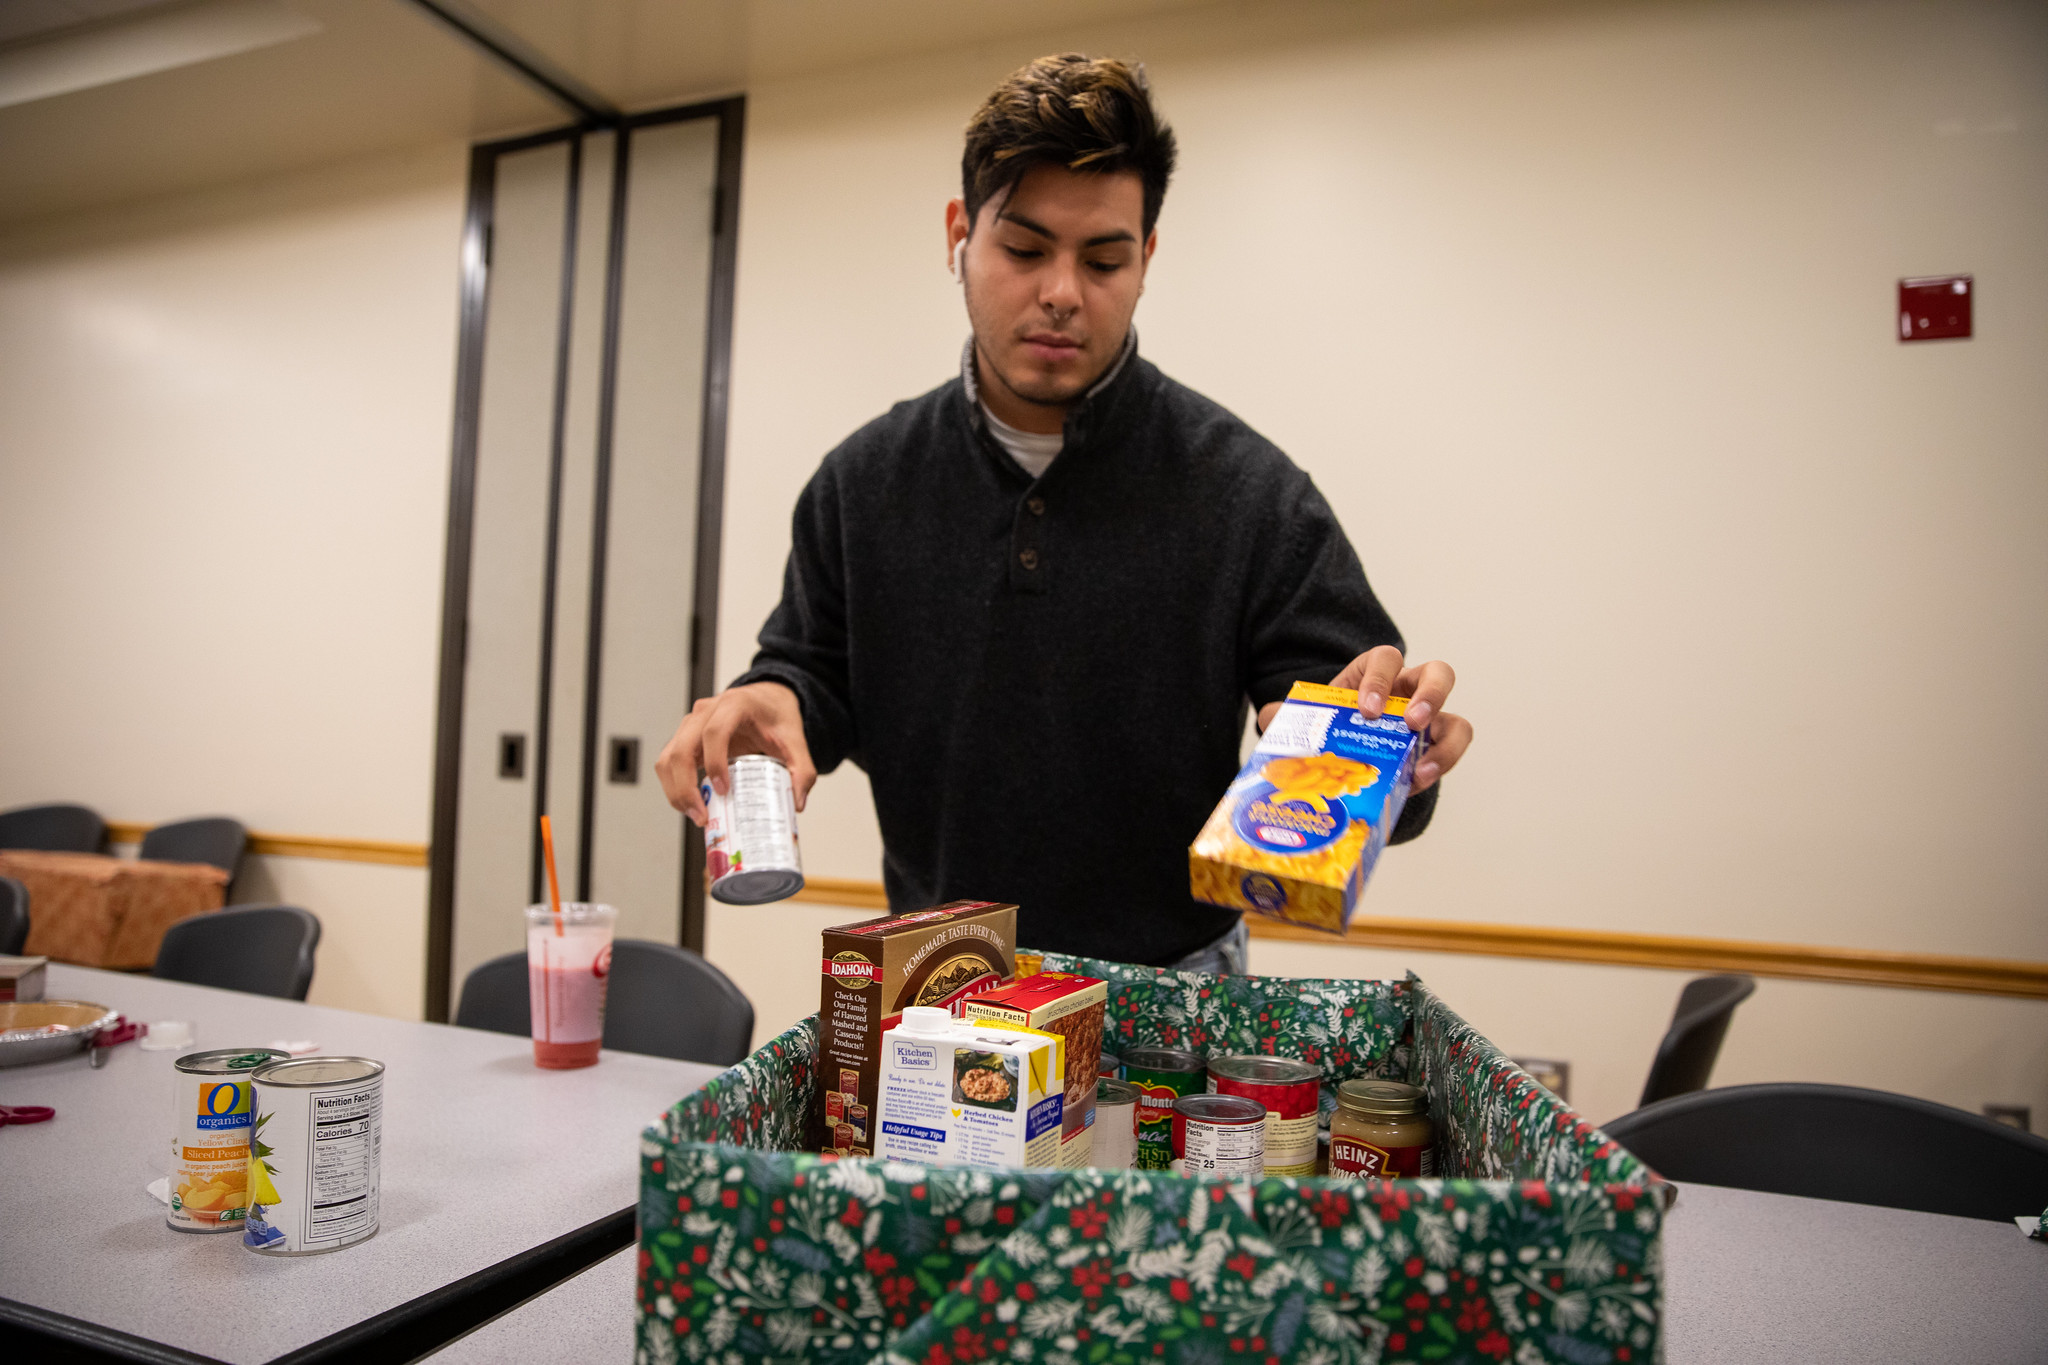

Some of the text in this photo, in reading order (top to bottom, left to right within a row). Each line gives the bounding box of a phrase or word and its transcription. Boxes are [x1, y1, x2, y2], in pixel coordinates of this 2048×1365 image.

[902, 931, 947, 977] HOMEMADE
[948, 924, 969, 940] TASTE
[970, 924, 990, 938] EVERY
[831, 962, 874, 976] IDAHOAN
[834, 991, 867, 1003] Check Out
[833, 1000, 868, 1014] Our Family
[967, 1004, 1025, 1022] Nutrition Facts
[833, 1010, 866, 1022] of Flavored
[832, 1019, 855, 1030] Mashed
[835, 1028, 864, 1041] Casserole
[833, 1038, 864, 1051] Products!!
[897, 1047, 933, 1058] Kitchen
[901, 1056, 930, 1066] Basics
[317, 1093, 370, 1109] Nutrition Facts
[199, 1115, 248, 1129] organics
[964, 1109, 1014, 1122] Herbed Chicken
[970, 1117, 999, 1126] Tomatoes
[316, 1120, 369, 1139] Calories 70
[885, 1124, 944, 1141] Helpful Usage Tips
[1187, 1121, 1214, 1132] Nutrition
[1187, 1128, 1203, 1137] Facts
[209, 1132, 235, 1140] organic
[198, 1139, 224, 1147] Yellow
[187, 1149, 215, 1160] Sliced
[1335, 1145, 1379, 1169] HEINZ
[212, 1161, 231, 1171] peach
[232, 1160, 247, 1168] juice
[1186, 1155, 1215, 1169] Calories 25
